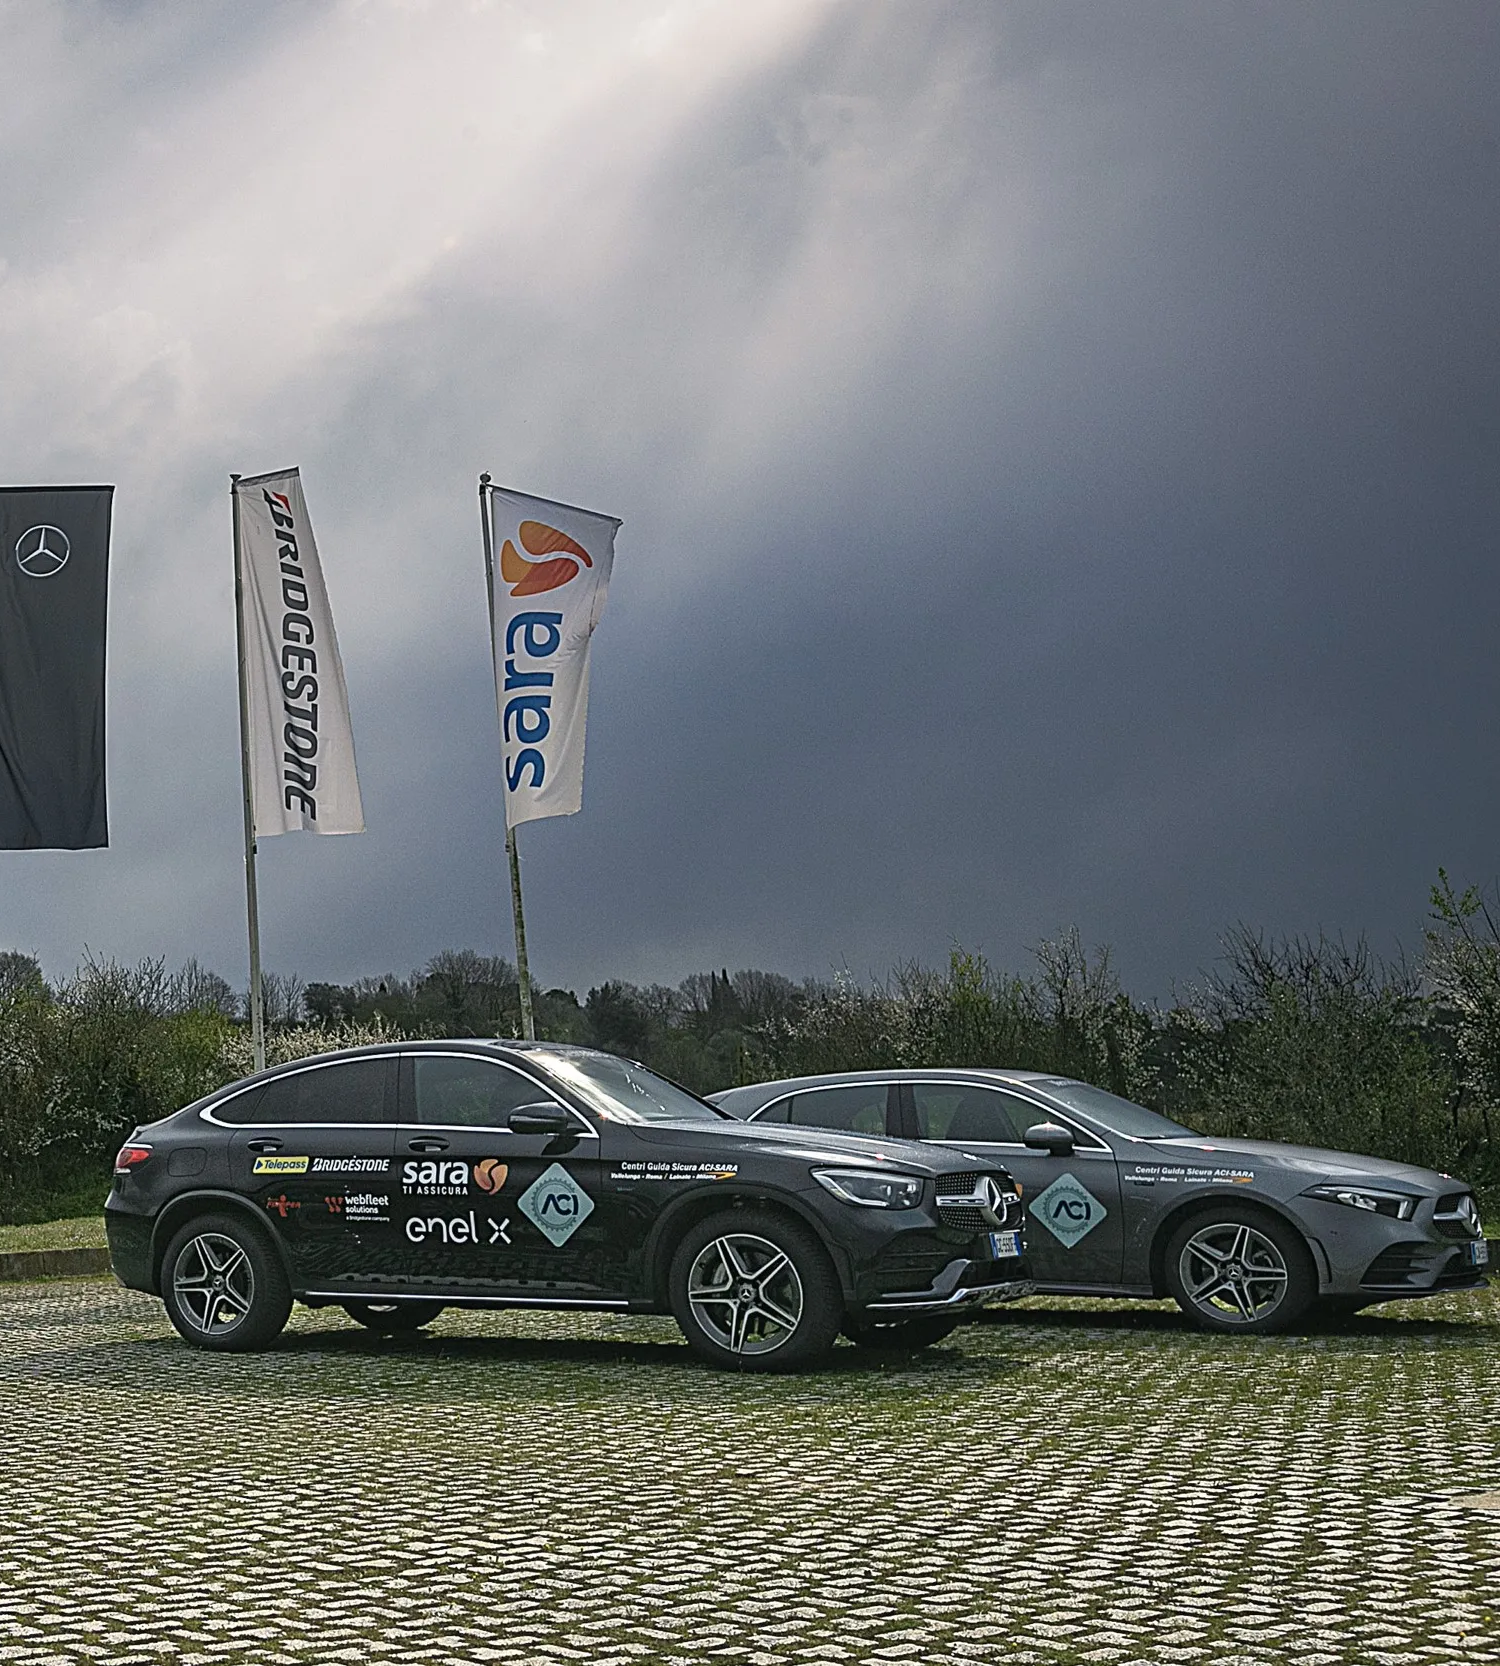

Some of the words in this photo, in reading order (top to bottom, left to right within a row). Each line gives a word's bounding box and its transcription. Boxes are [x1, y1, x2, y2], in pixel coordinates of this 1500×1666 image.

[262, 488, 319, 821] BRIDGESTONE
[504, 611, 563, 792] sara
[264, 1160, 306, 1171] Telepass
[311, 1158, 390, 1172] BRIDGESTONE
[621, 1162, 646, 1170] Centri
[647, 1162, 670, 1171] Guida
[671, 1162, 697, 1171] Sicura
[1135, 1166, 1160, 1175] Centri
[1161, 1167, 1185, 1175] Guida
[1186, 1167, 1212, 1176] Sicura
[403, 1161, 468, 1185] sara
[403, 1186, 412, 1195] TI
[417, 1186, 469, 1195] ASSICURA
[345, 1194, 389, 1206] webfleet
[541, 1193, 579, 1216] ACI
[345, 1205, 379, 1214] solutions
[1053, 1200, 1091, 1220] ACI
[406, 1211, 479, 1244] enel
